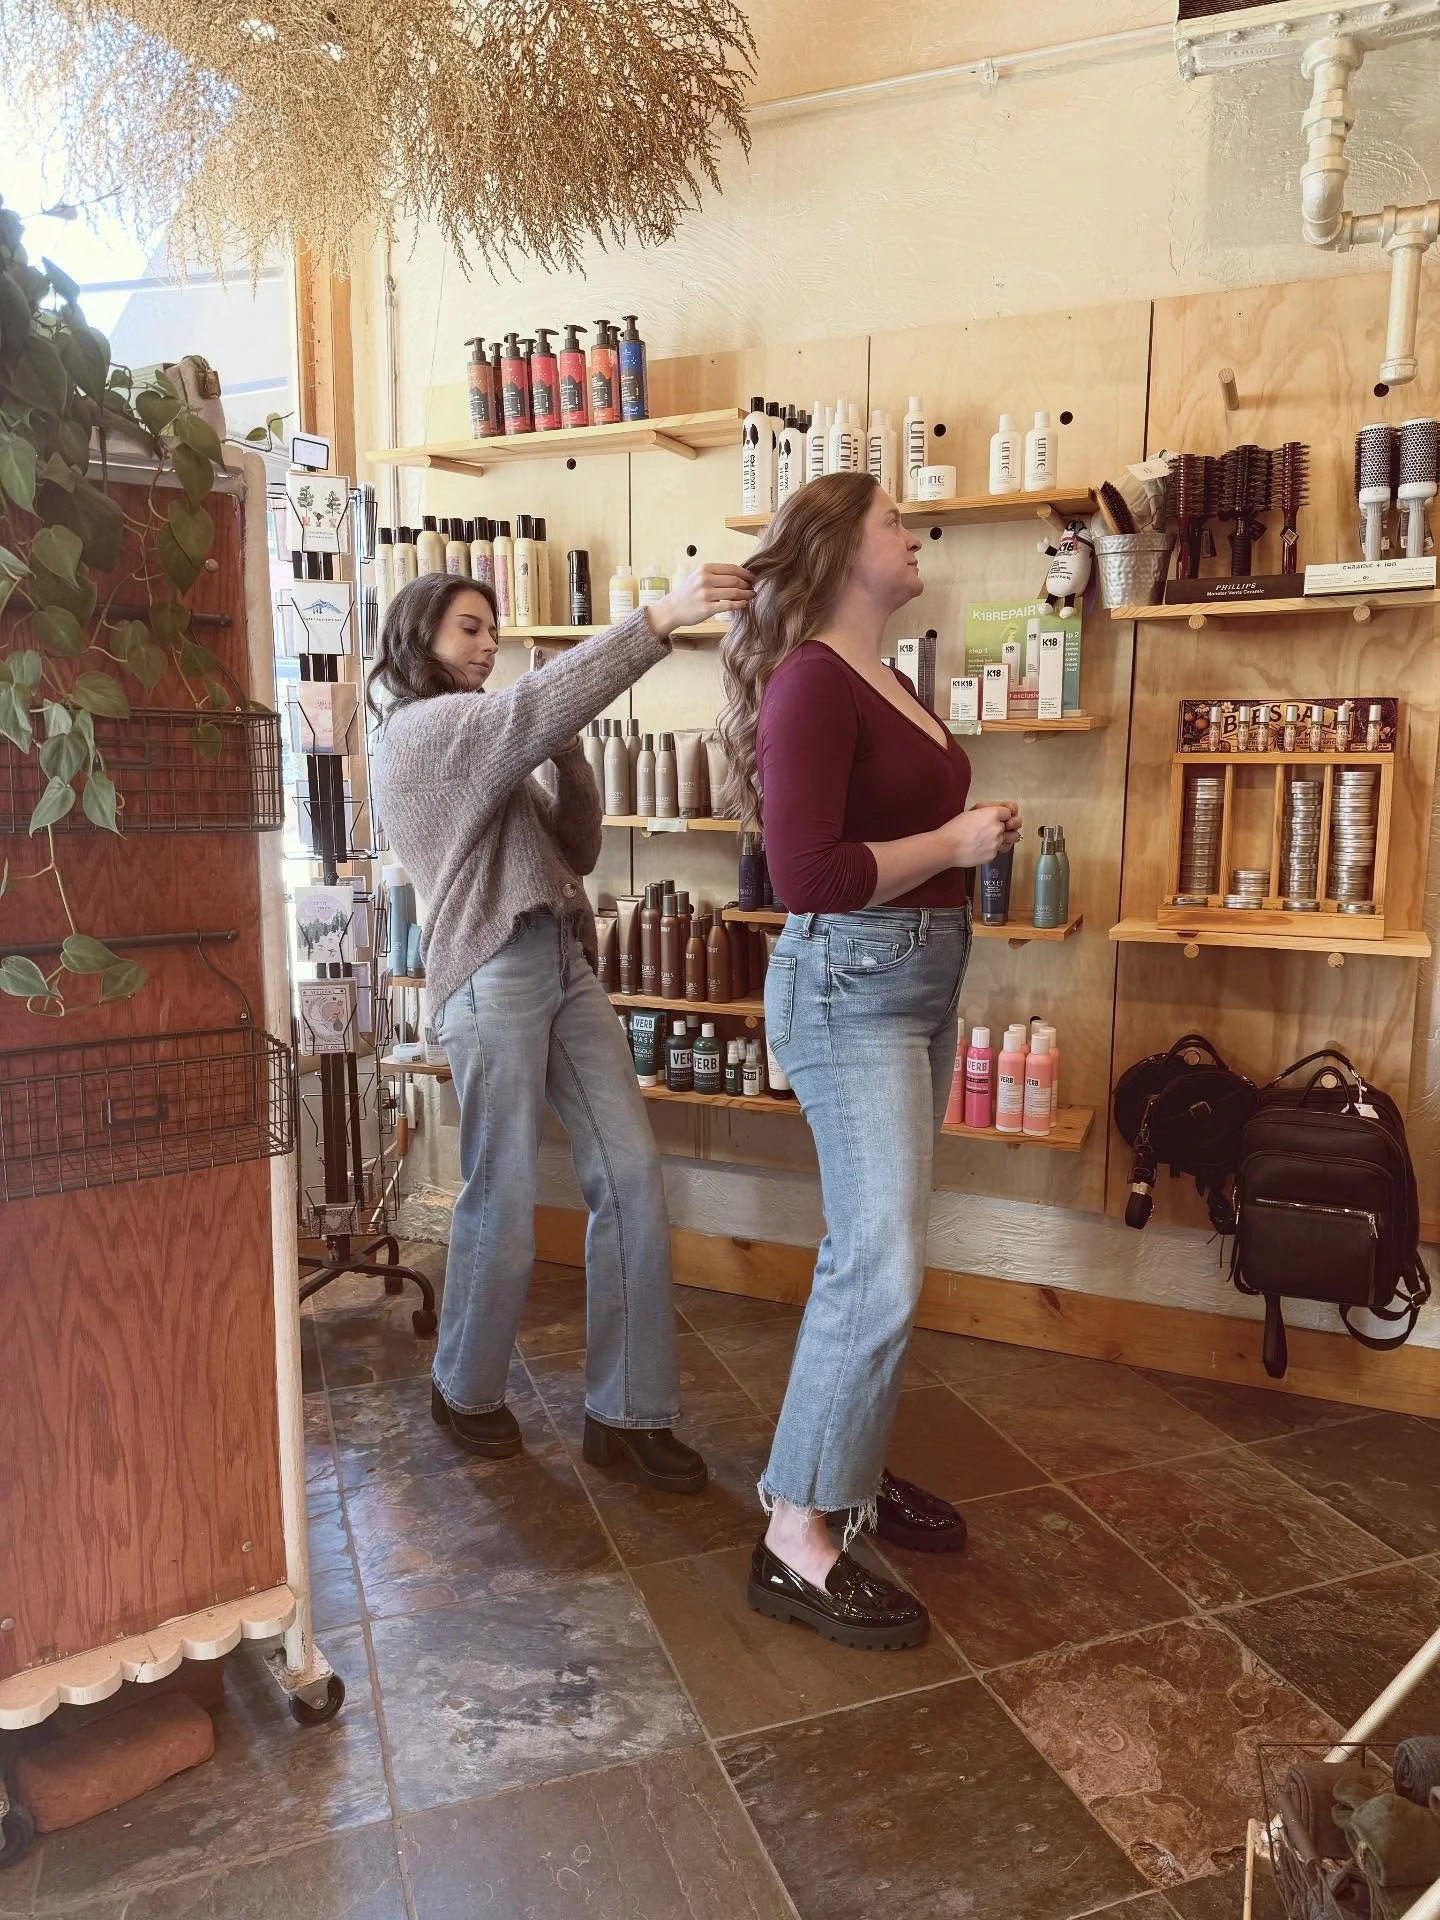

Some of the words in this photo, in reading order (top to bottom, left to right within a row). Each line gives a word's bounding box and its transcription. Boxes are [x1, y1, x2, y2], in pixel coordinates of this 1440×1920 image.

[1215, 582, 1257, 591] PHILLIPS
[1042, 638, 1058, 647] K18
[900, 645, 914, 653] K18
[987, 669, 1002, 678] K18
[635, 1018, 653, 1029] VERB
[673, 1053, 692, 1065] VER
[967, 1061, 988, 1072] VERB
[1001, 1076, 1014, 1084] VERB
